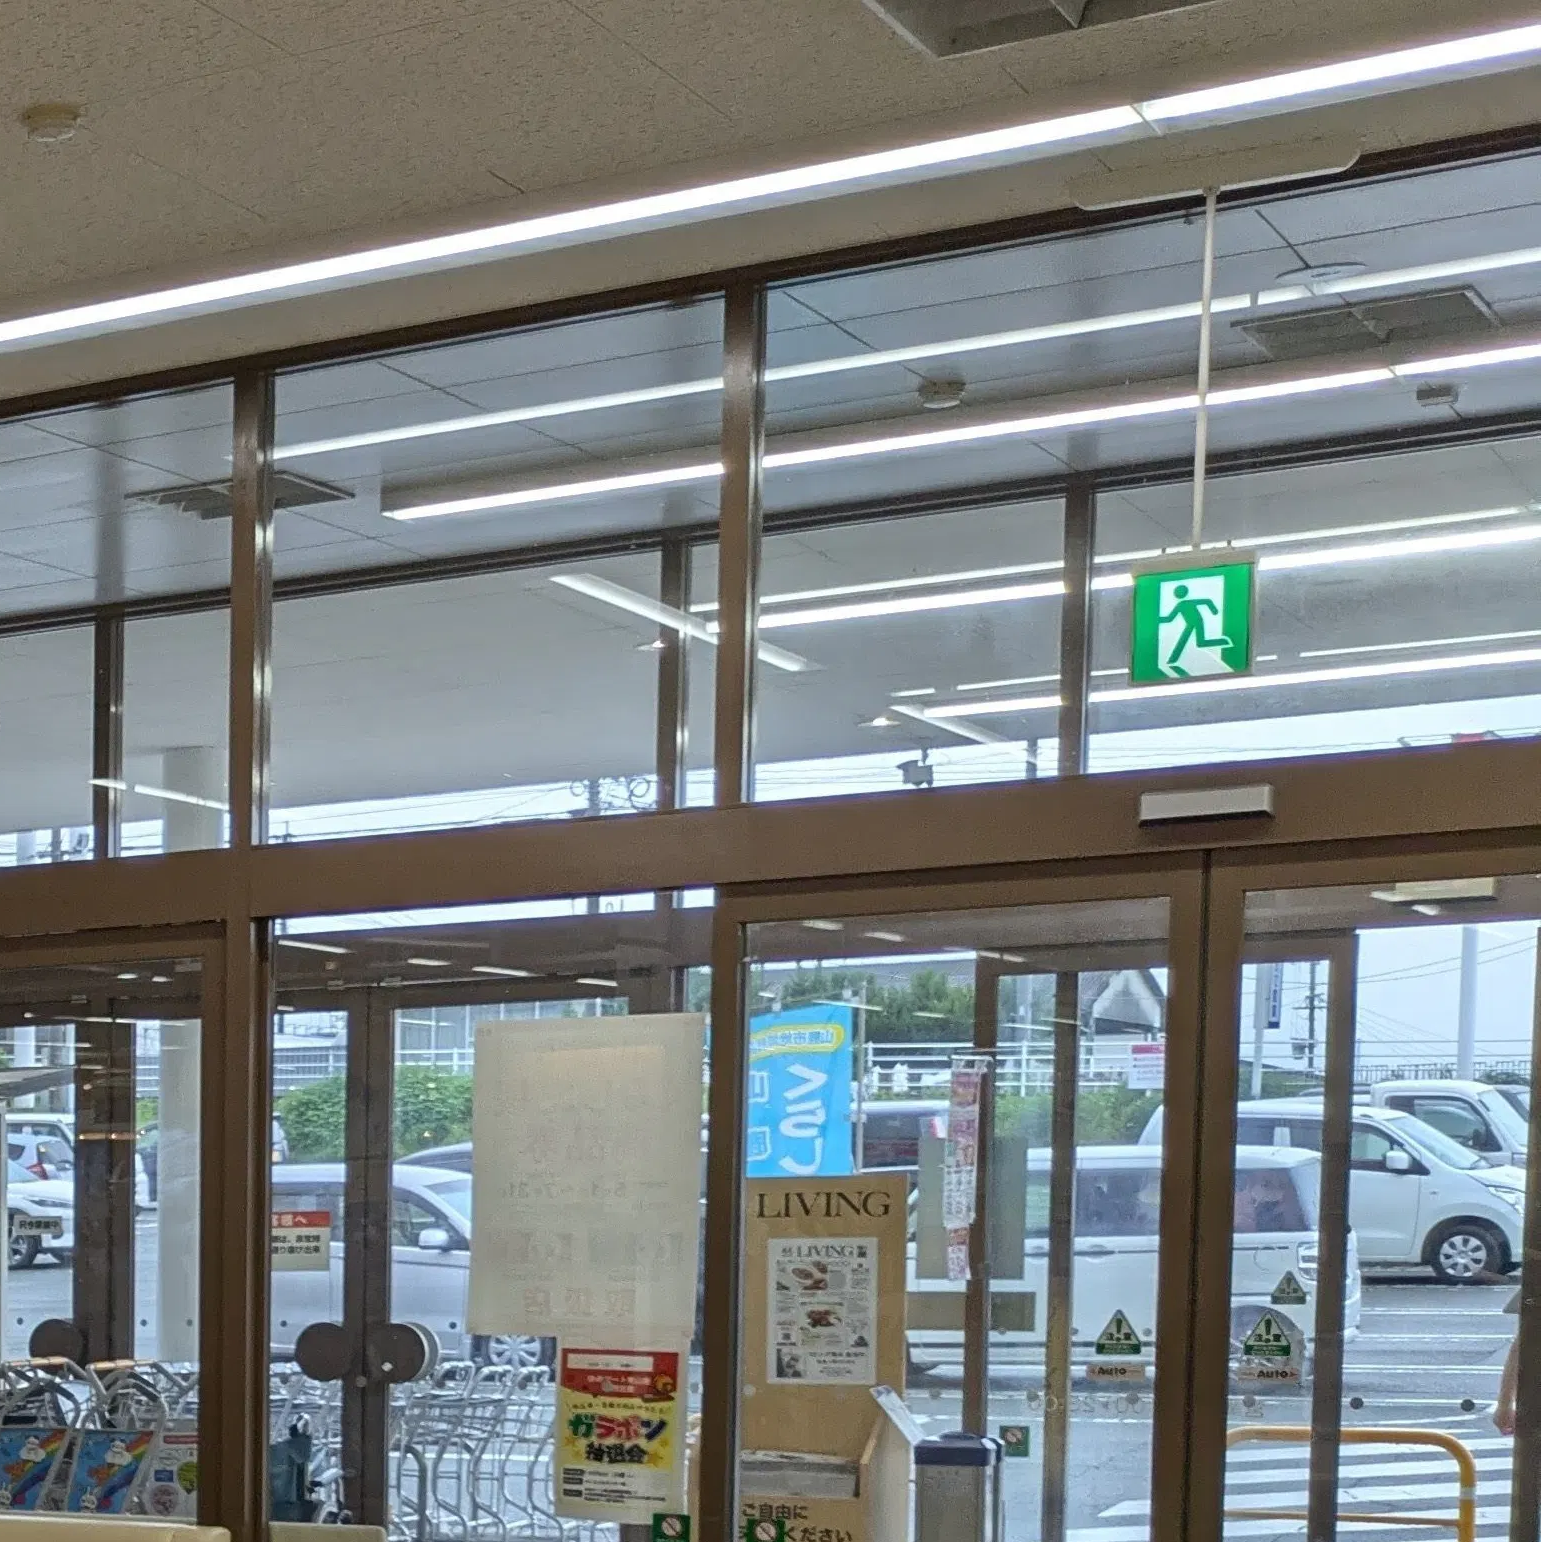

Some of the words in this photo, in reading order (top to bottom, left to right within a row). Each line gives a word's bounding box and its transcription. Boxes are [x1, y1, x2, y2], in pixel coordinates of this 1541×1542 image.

[756, 1191, 891, 1219] LIVING
[796, 1244, 854, 1258] LIVING
[1097, 1366, 1128, 1377] Auto
[1256, 1369, 1289, 1379] Auto
[568, 1411, 668, 1443] ガラポン
[585, 1441, 648, 1464] 抽選会
[741, 1502, 809, 1520] ご自由に
